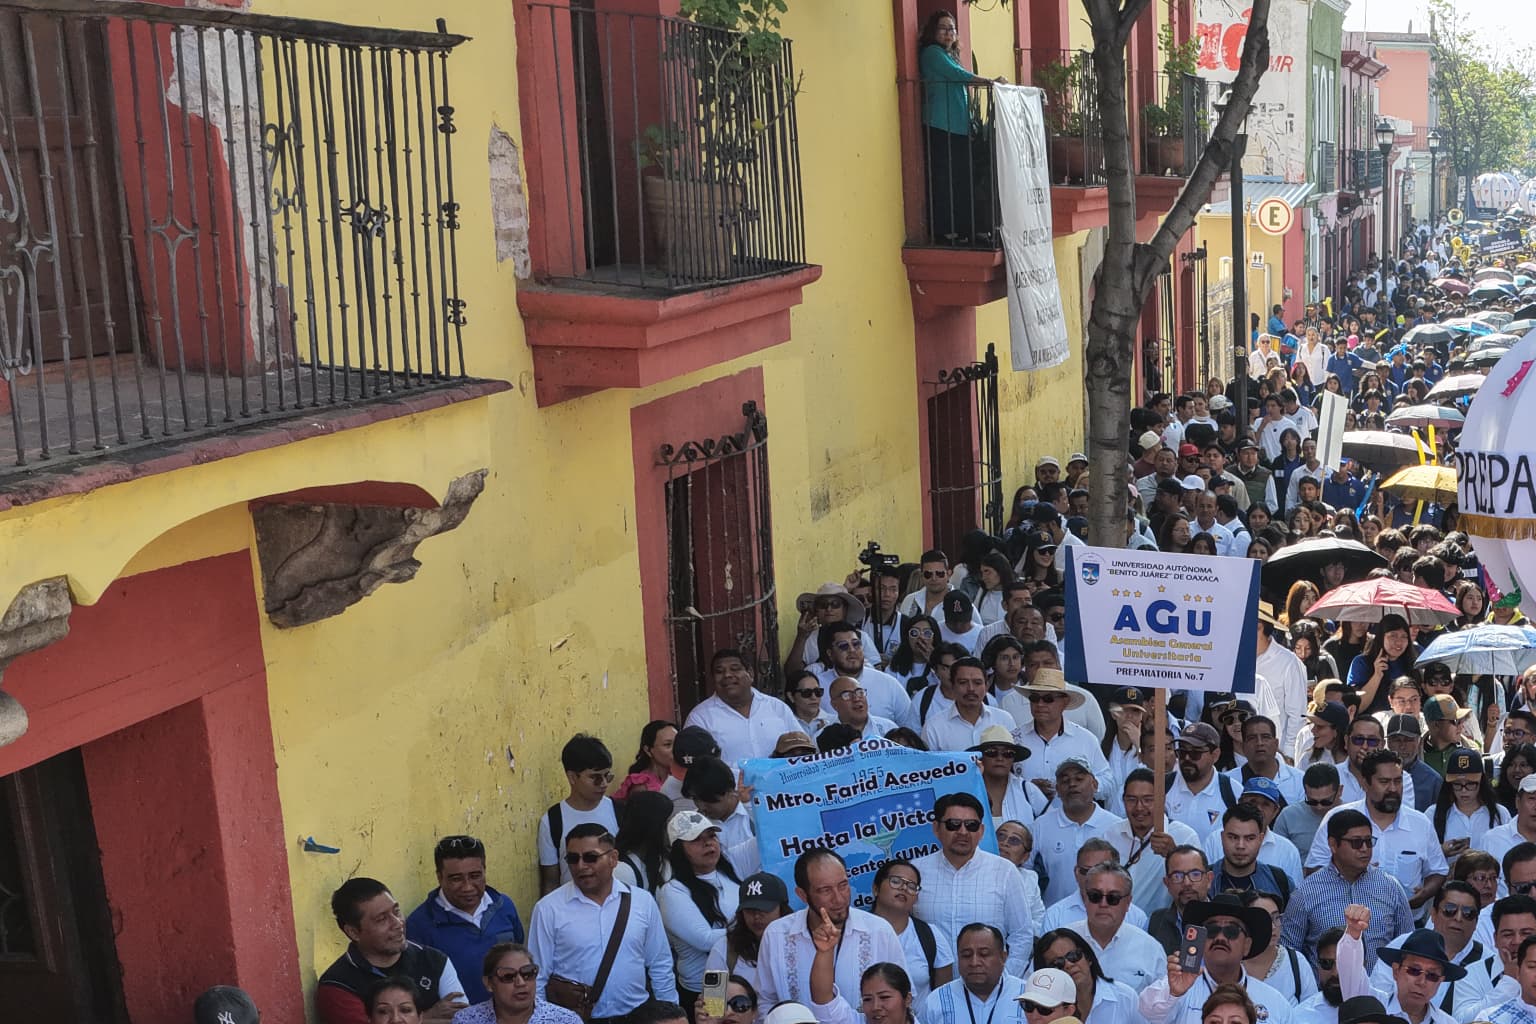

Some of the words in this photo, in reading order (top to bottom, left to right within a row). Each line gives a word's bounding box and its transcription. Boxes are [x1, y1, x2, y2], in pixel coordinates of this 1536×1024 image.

[1268, 206, 1281, 227] E
[1111, 560, 1165, 571] UNIVERSIDAD
[1165, 563, 1213, 574] AUTÓNOMA
[1173, 573, 1185, 581] DE
[1185, 574, 1220, 583] OAXACA
[1113, 599, 1212, 637] AGU
[1109, 635, 1166, 648] Asamblea
[1168, 639, 1213, 651] General
[1122, 648, 1202, 662] Universitaria
[1116, 667, 1182, 680] PREPARATORIA
[767, 791, 822, 812] Mtro.
[825, 774, 878, 800] Farid
[884, 761, 967, 787] Acevedo
[780, 831, 850, 857] Hasta
[854, 822, 876, 840] la
